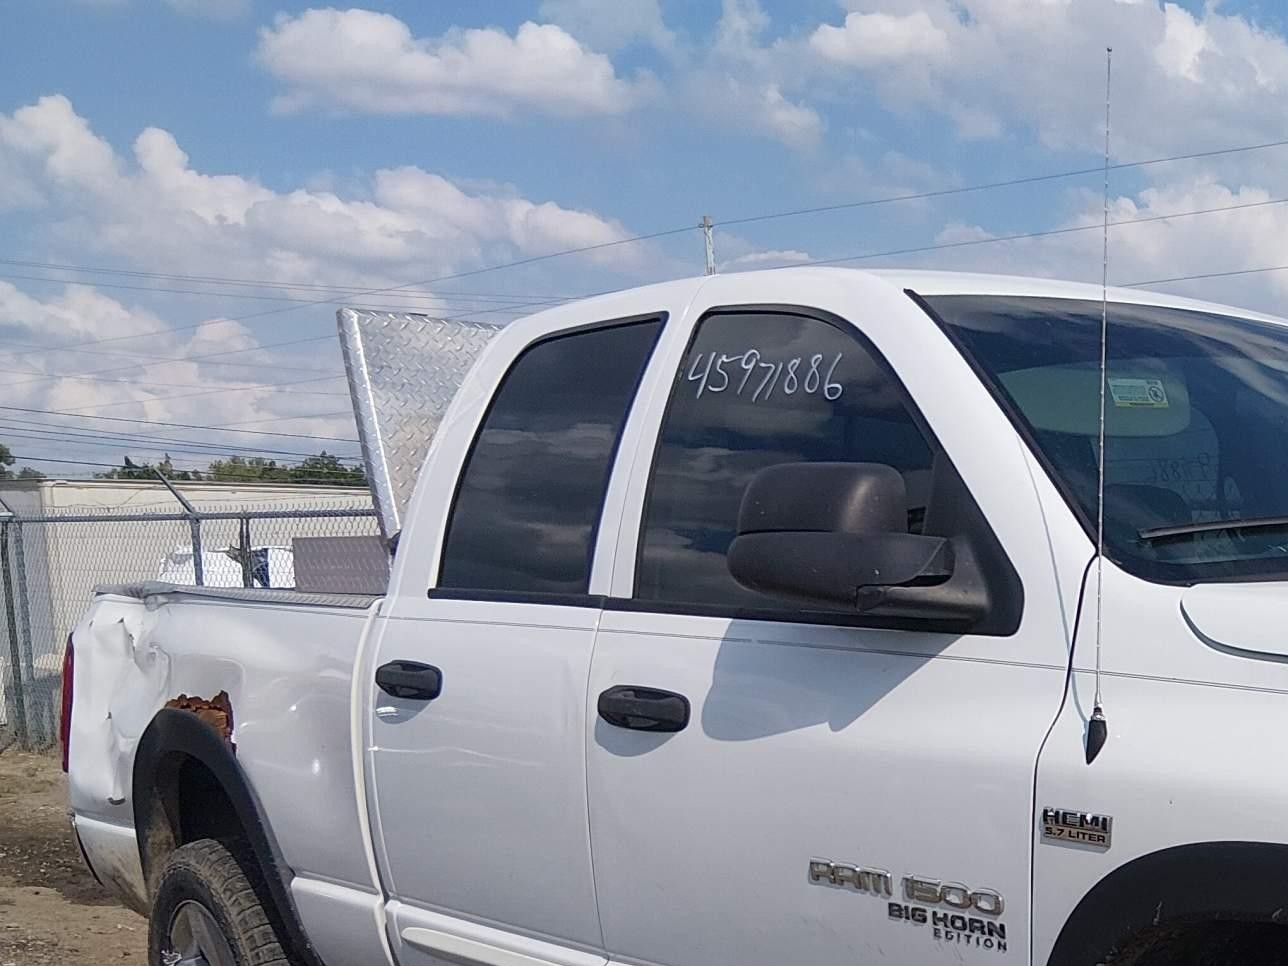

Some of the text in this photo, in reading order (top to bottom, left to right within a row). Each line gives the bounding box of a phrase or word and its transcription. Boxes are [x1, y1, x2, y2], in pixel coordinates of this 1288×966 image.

[687, 349, 844, 402] 45971886
[1042, 806, 1112, 833] HEMI
[1044, 826, 1107, 845] 5.7 LITER
[807, 856, 1006, 916] RAM 1500
[887, 901, 1007, 940] BIG HORN
[932, 928, 1008, 953] EDITION
